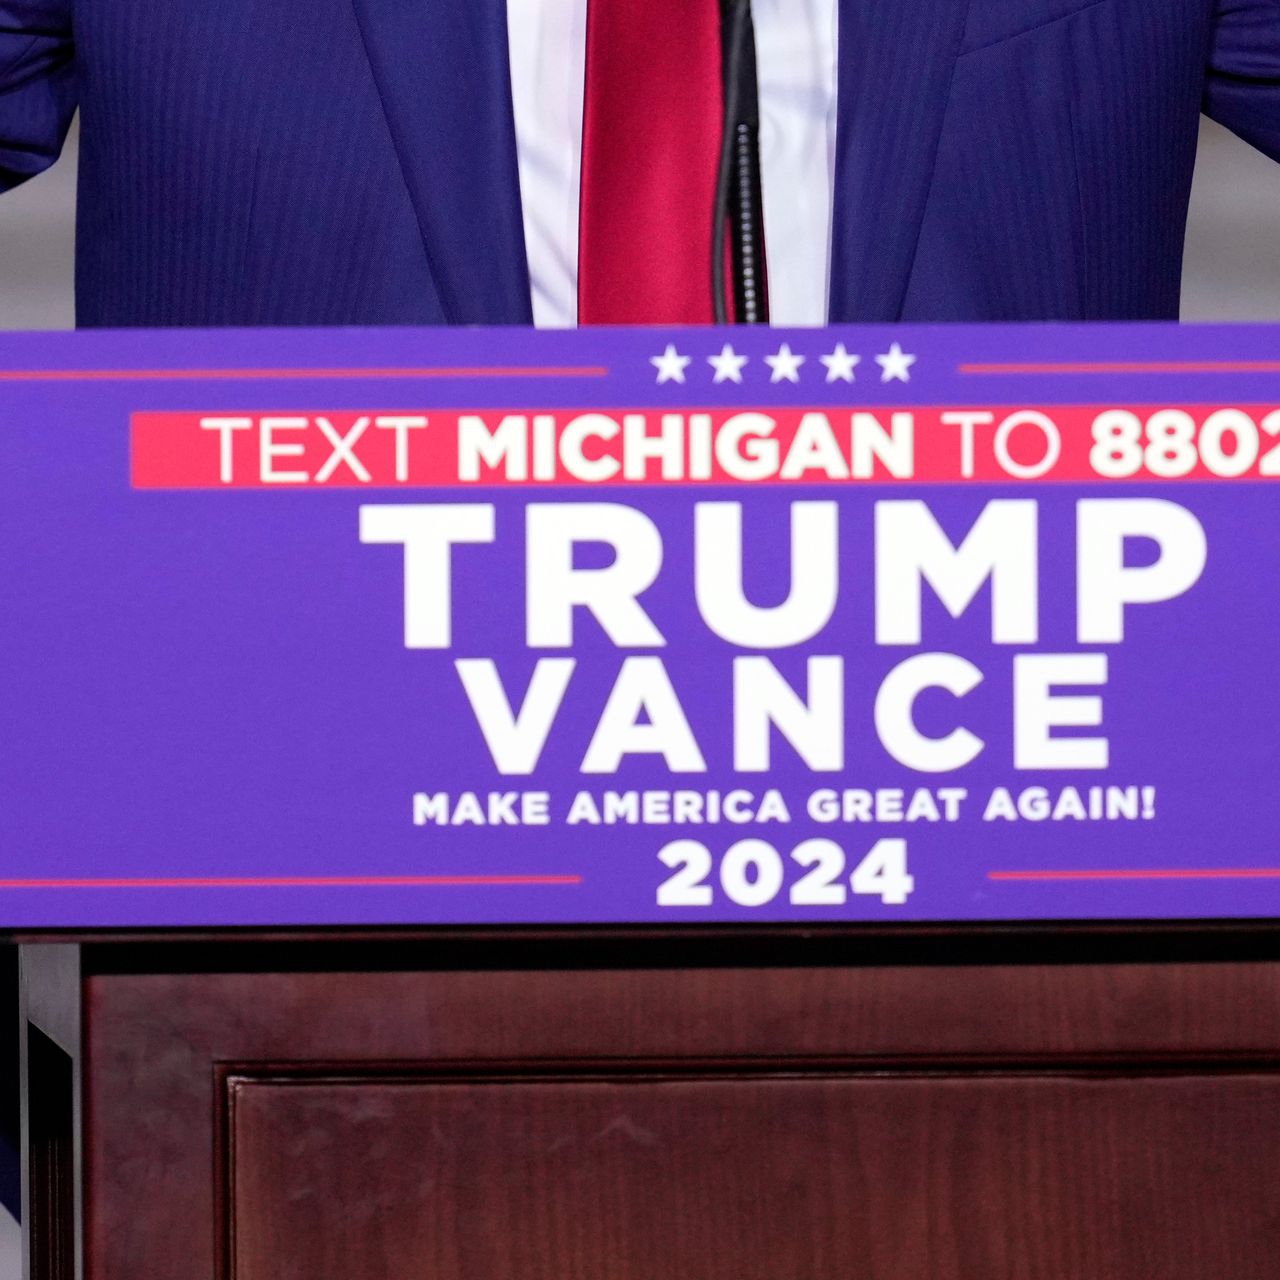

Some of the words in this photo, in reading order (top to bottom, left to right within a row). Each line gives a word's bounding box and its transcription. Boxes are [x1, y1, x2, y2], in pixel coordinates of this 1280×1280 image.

[201, 412, 428, 484] TEXT
[458, 413, 914, 482] MICHIGAN
[942, 410, 1061, 478] TO
[359, 500, 1208, 649] TRUMP
[454, 653, 1109, 775] VANCE
[413, 792, 551, 826] MAKE
[566, 789, 792, 825] AMERICA
[807, 788, 967, 823] GREAT
[983, 786, 1157, 821] AGAIN!
[656, 838, 914, 907] 2024
